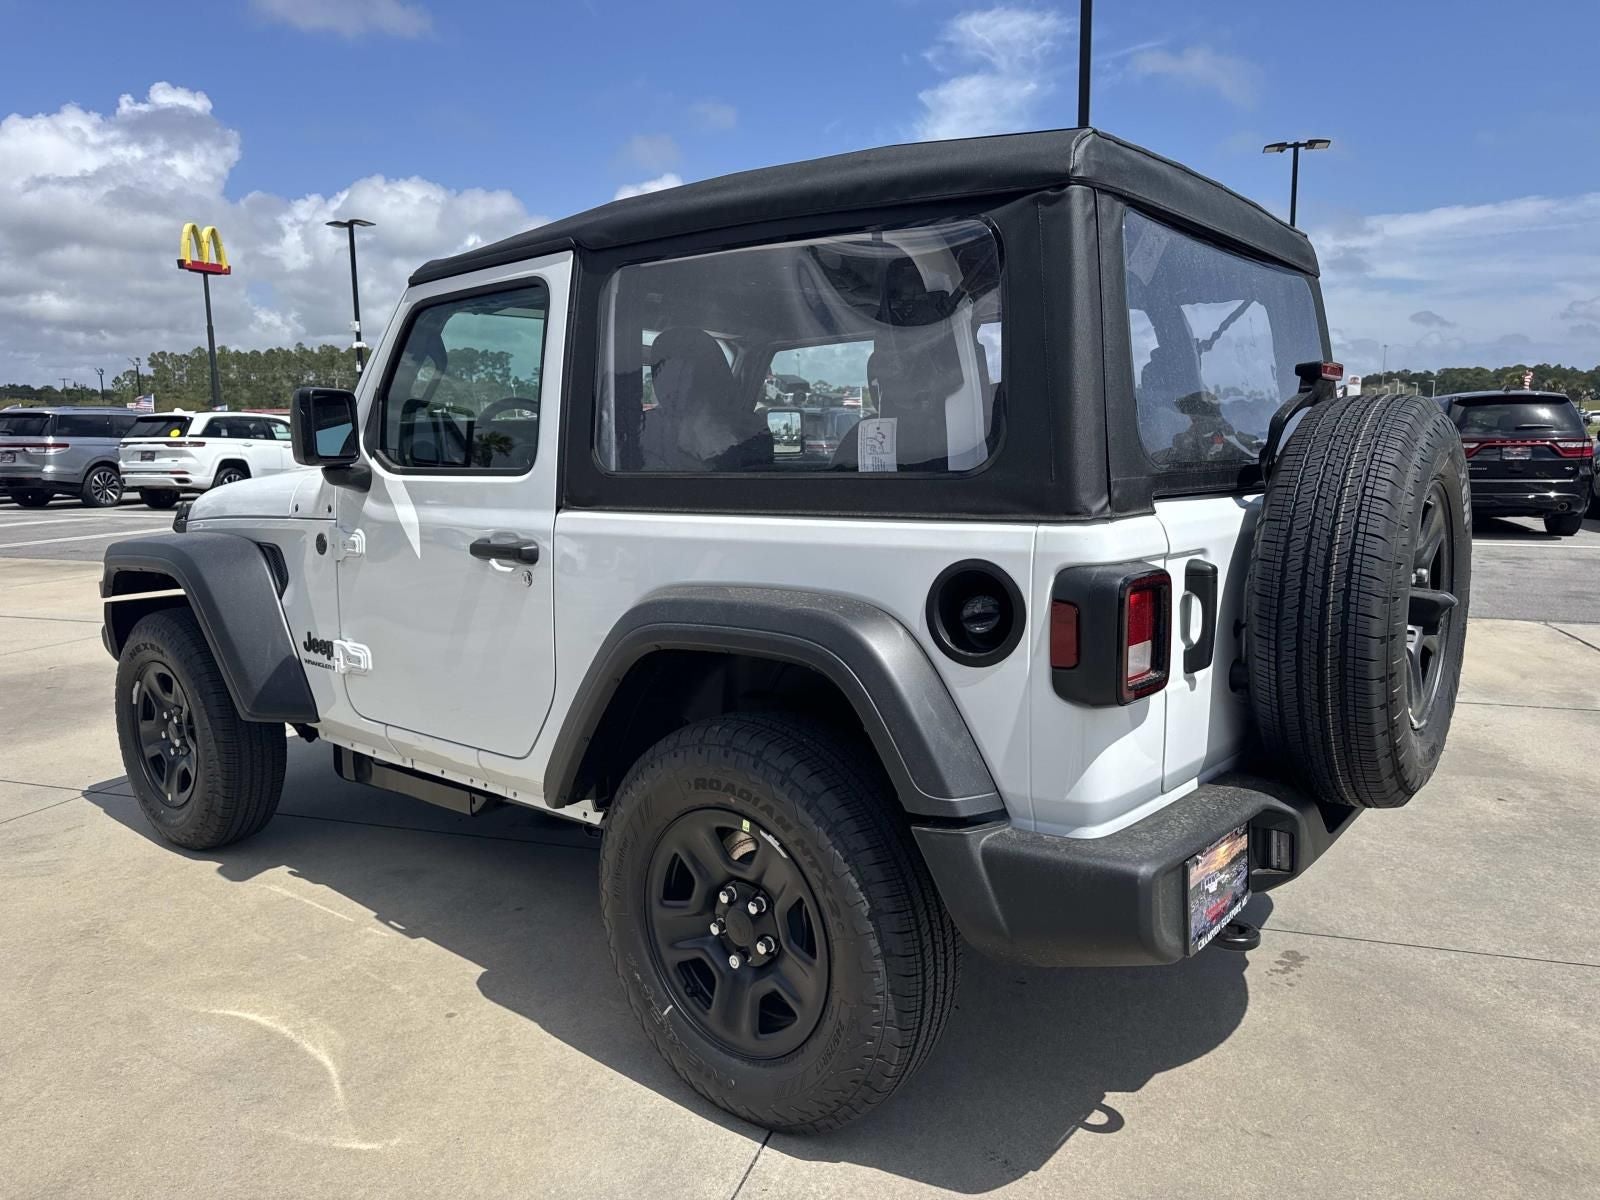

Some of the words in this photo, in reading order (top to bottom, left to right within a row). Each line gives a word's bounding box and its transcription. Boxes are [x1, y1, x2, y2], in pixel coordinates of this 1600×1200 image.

[128, 642, 165, 662] NEXEN
[303, 631, 334, 661] Jeep
[303, 657, 332, 670] WRANGLER
[693, 777, 796, 834] ROADIAN
